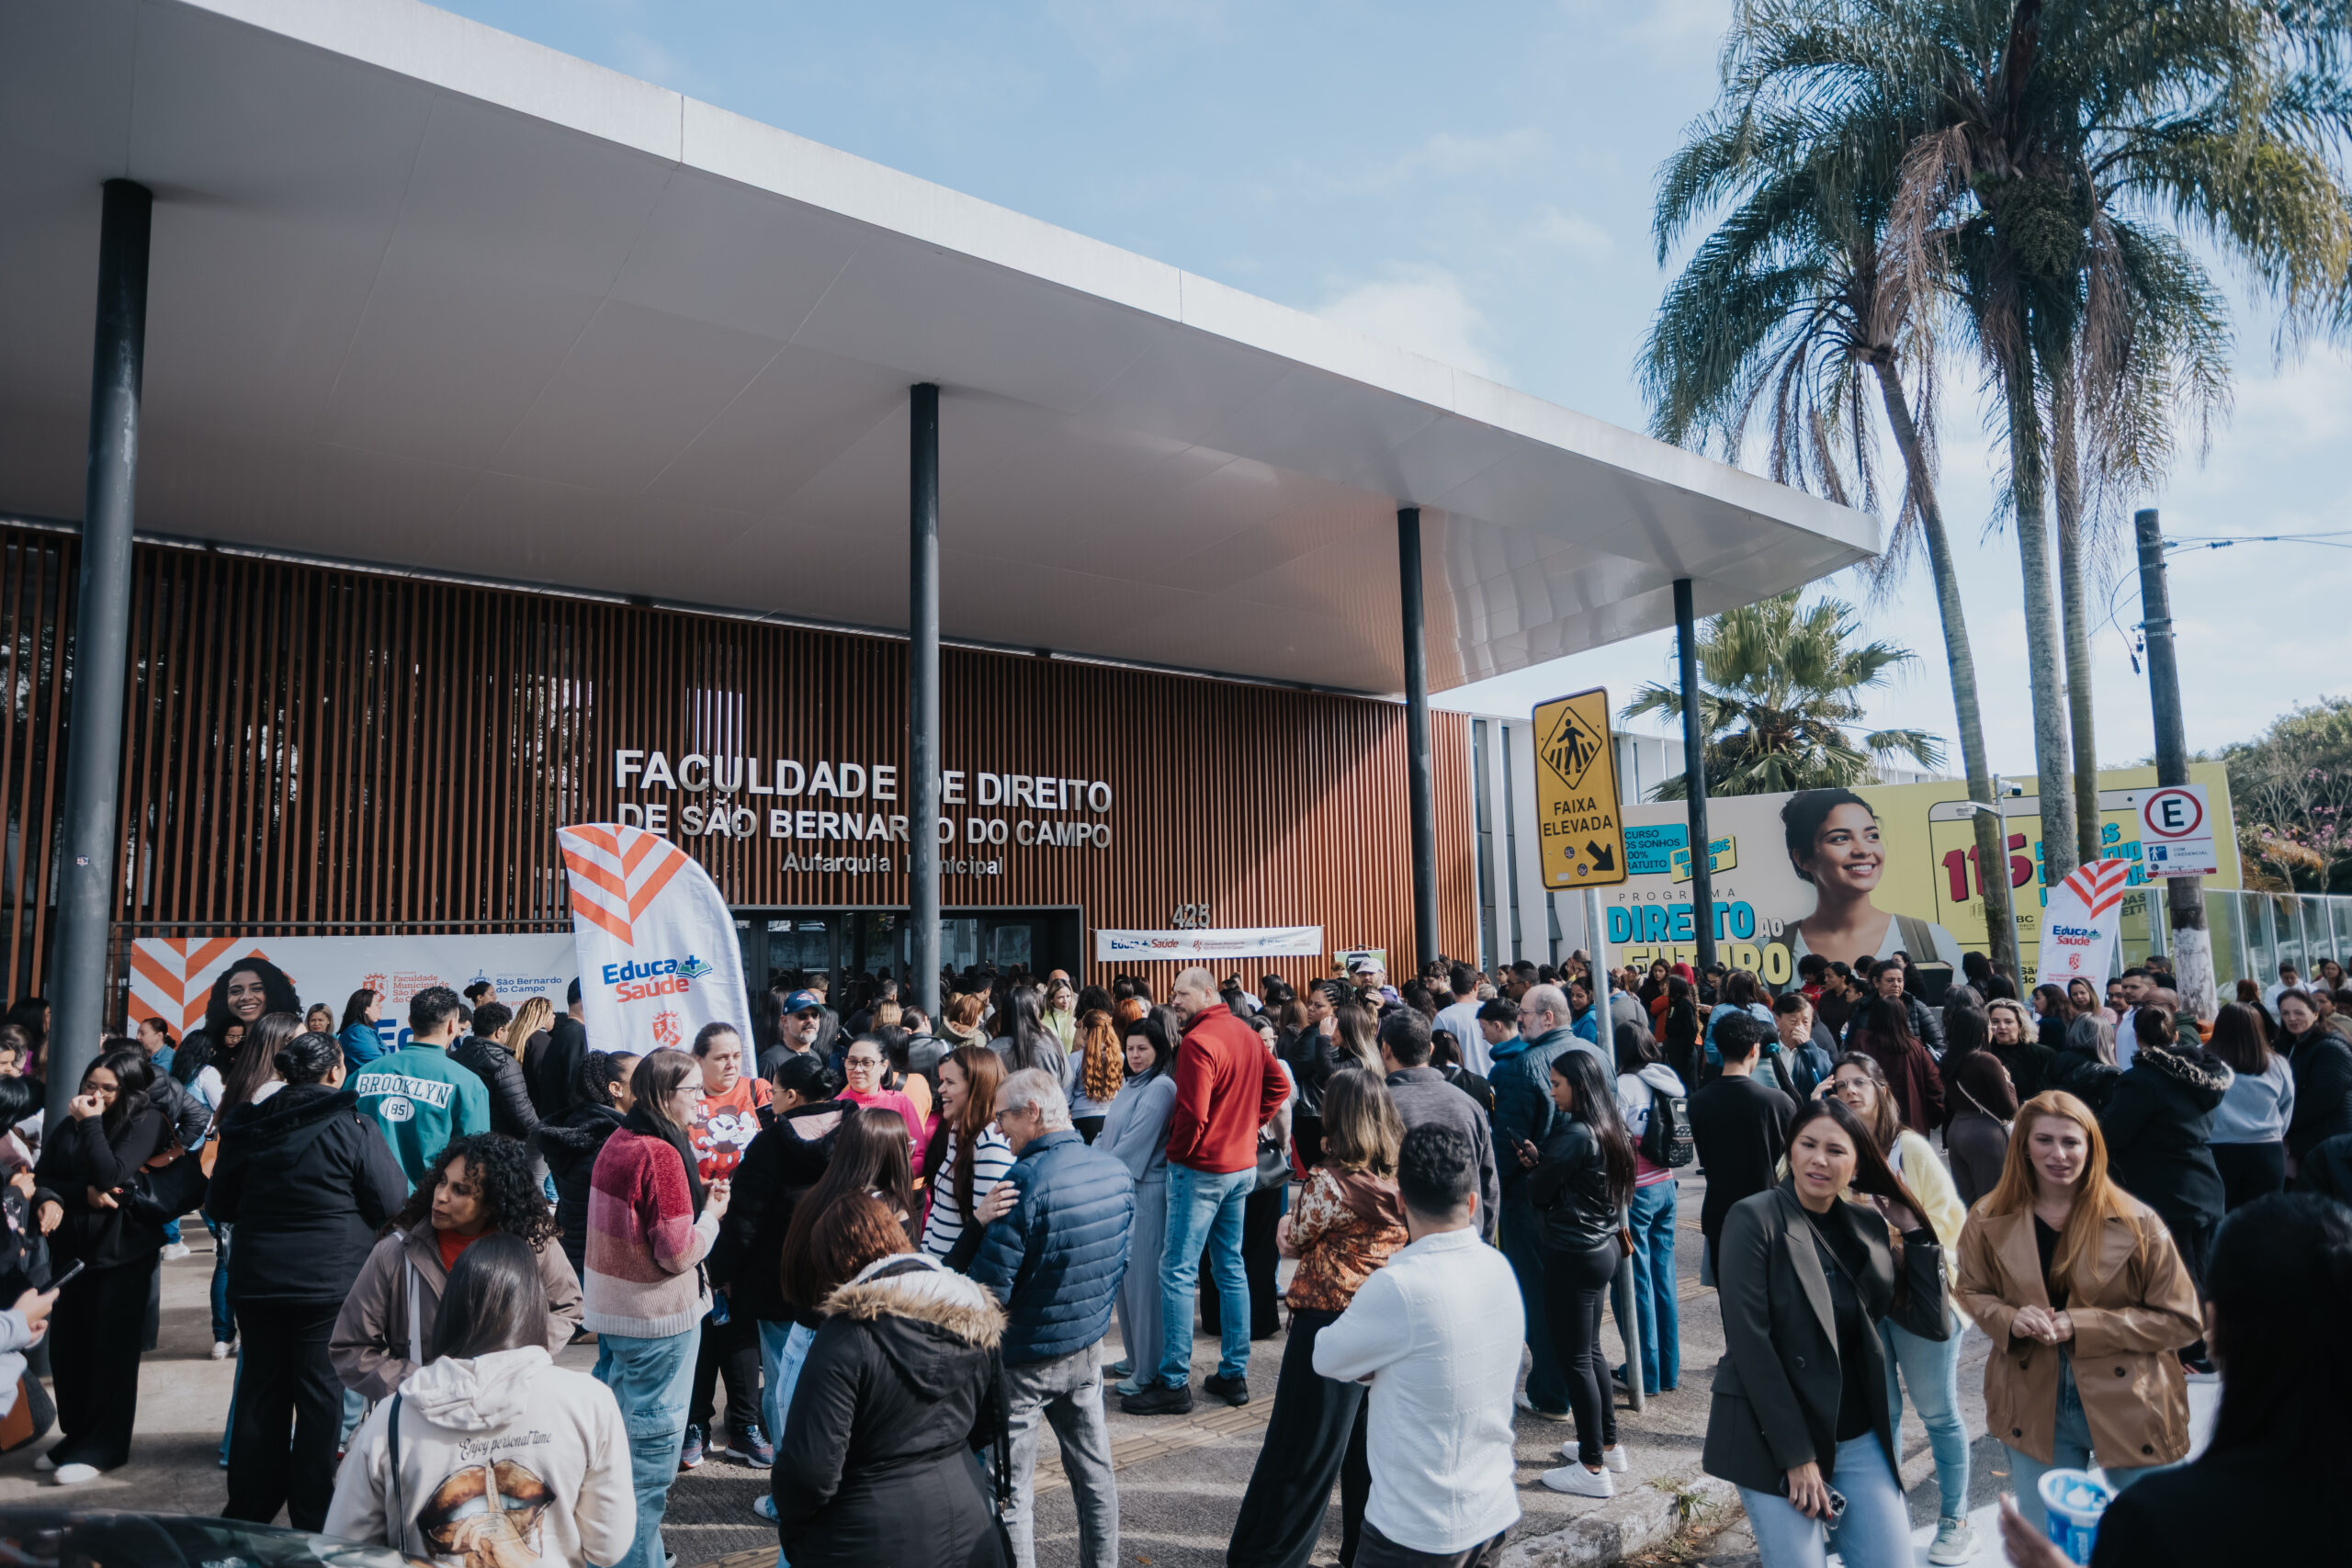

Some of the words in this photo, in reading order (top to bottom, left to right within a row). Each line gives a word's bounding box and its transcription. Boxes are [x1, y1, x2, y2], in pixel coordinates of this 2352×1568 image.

[616, 749, 897, 800] FACULDADE
[938, 769, 966, 806] E
[978, 772, 1112, 814] DIREITO
[1554, 796, 1597, 816] FAIXA
[2161, 799, 2185, 828] E
[618, 802, 668, 834] DE
[680, 797, 757, 838] SÃO
[769, 808, 955, 844] BERNARO
[967, 818, 1009, 845] DO
[1015, 820, 1111, 849] CAMPO
[1544, 815, 1613, 837] ELEVADA
[1624, 829, 1659, 840] CURSO
[1638, 837, 1680, 849] SONHOS
[1627, 851, 1648, 860] 00%
[781, 852, 891, 876] Autarquia
[1627, 859, 1668, 870] RATUITO
[1619, 888, 1736, 902] PROGRMA
[1172, 903, 1211, 928] 425
[1606, 900, 1756, 943] DIRETO
[1759, 918, 1784, 939] AO
[2052, 925, 2088, 936] Educa
[1151, 938, 1179, 948] Saúde
[2057, 935, 2090, 946] Saúde
[393, 974, 438, 982] Faculdade
[602, 959, 678, 985] Educa
[393, 980, 437, 989] Municipal
[516, 976, 562, 986] Bernardo
[616, 974, 689, 1002] Saúde
[392, 988, 409, 997] São
[511, 986, 546, 994] Campo
[358, 1076, 449, 1105] BROOKLYN
[390, 1103, 405, 1116] 85
[459, 1438, 489, 1461] Enjoy
[490, 1431, 530, 1455] personal
